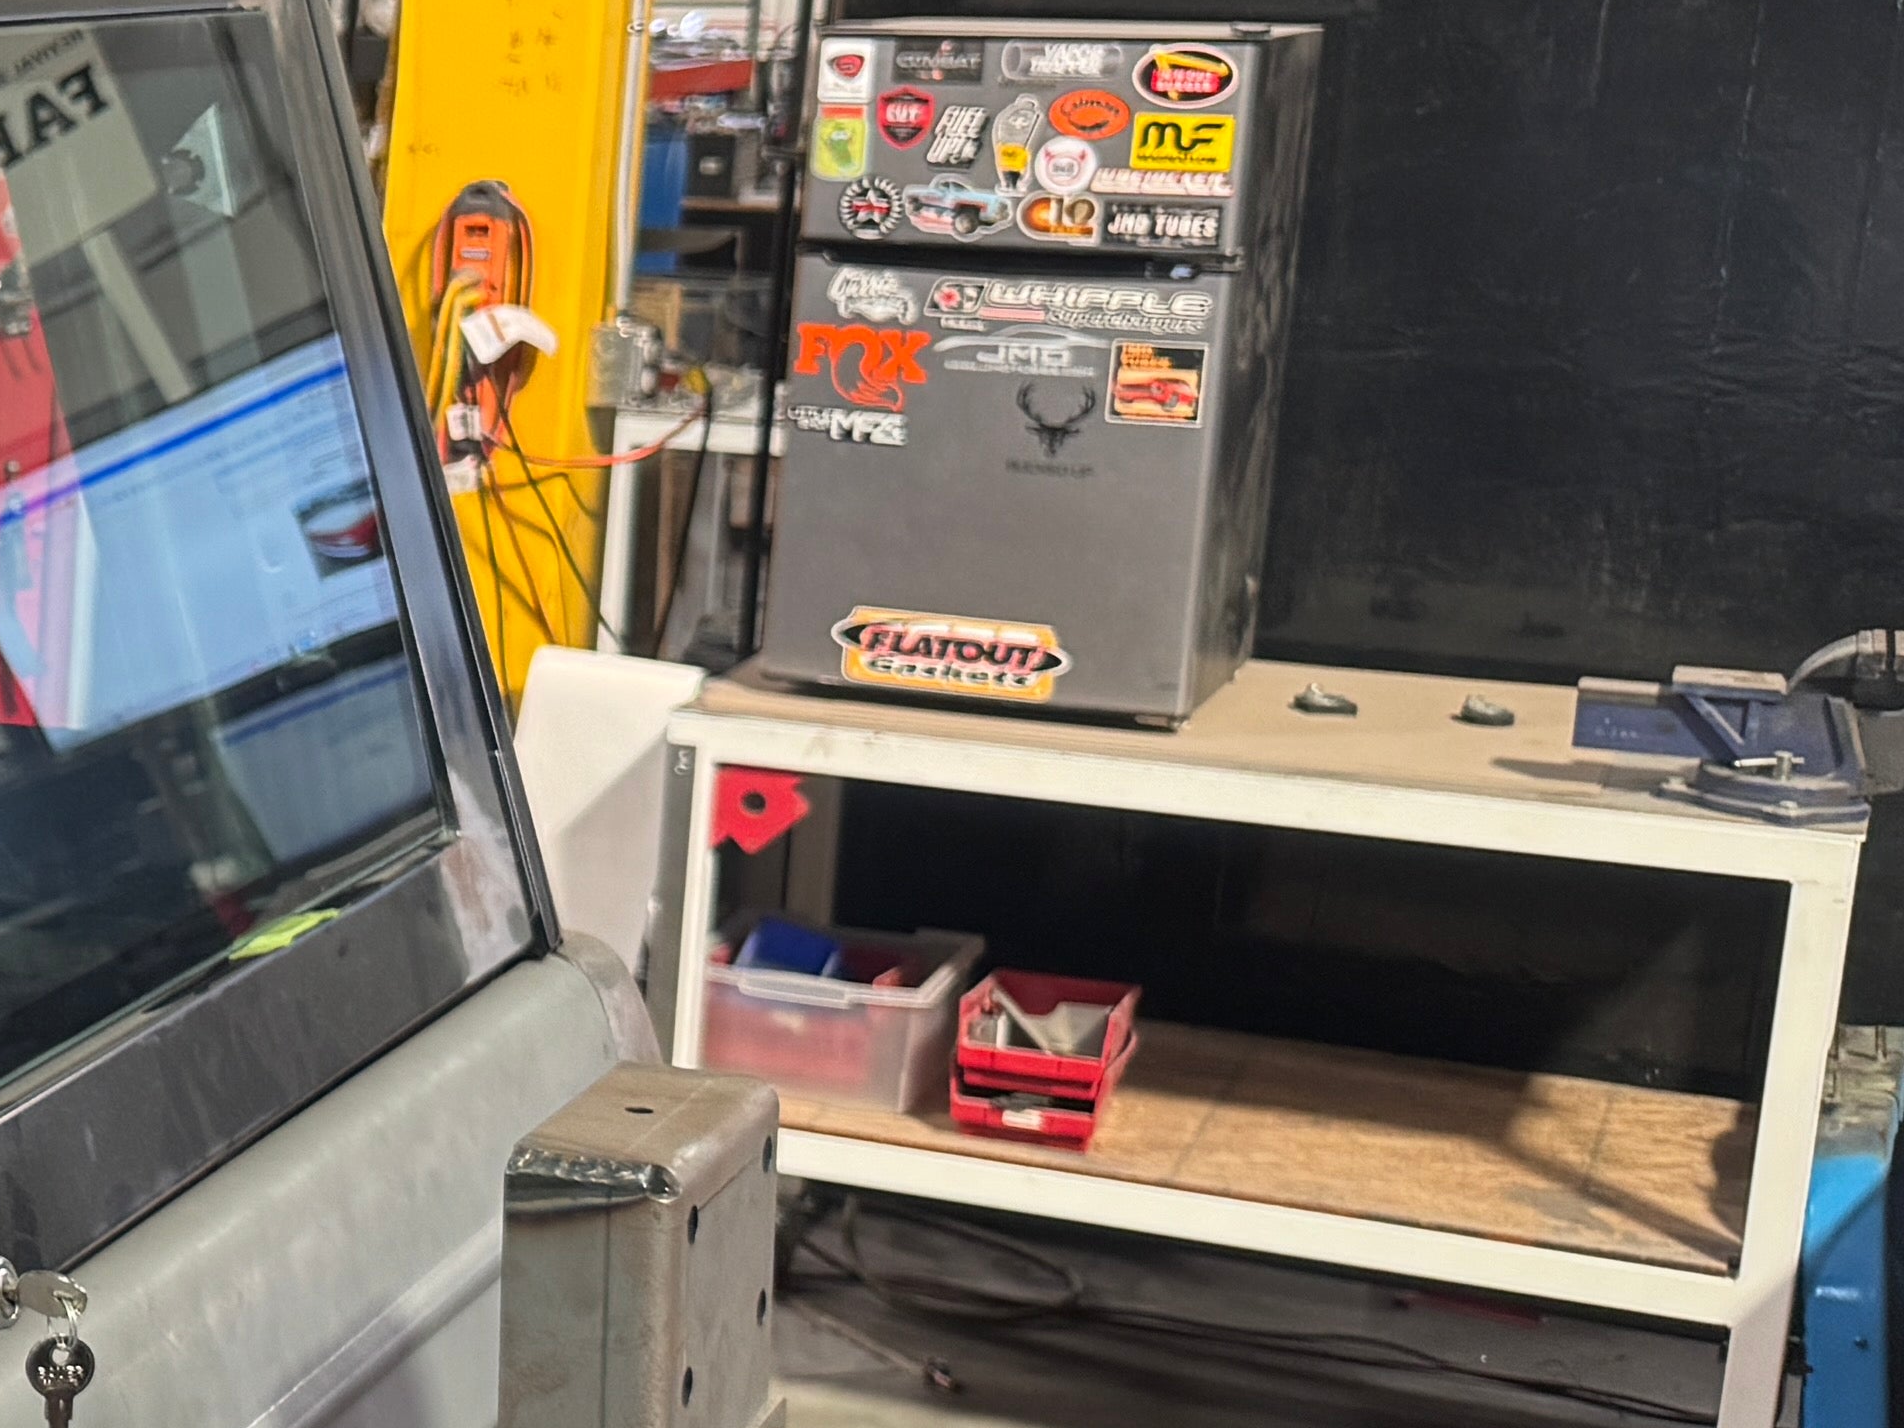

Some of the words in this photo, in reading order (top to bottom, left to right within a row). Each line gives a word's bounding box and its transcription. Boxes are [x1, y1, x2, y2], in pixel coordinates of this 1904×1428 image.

[990, 280, 1213, 318] WHIPPLE
[794, 322, 932, 410] FOX
[860, 622, 1046, 675] FLATOUT
